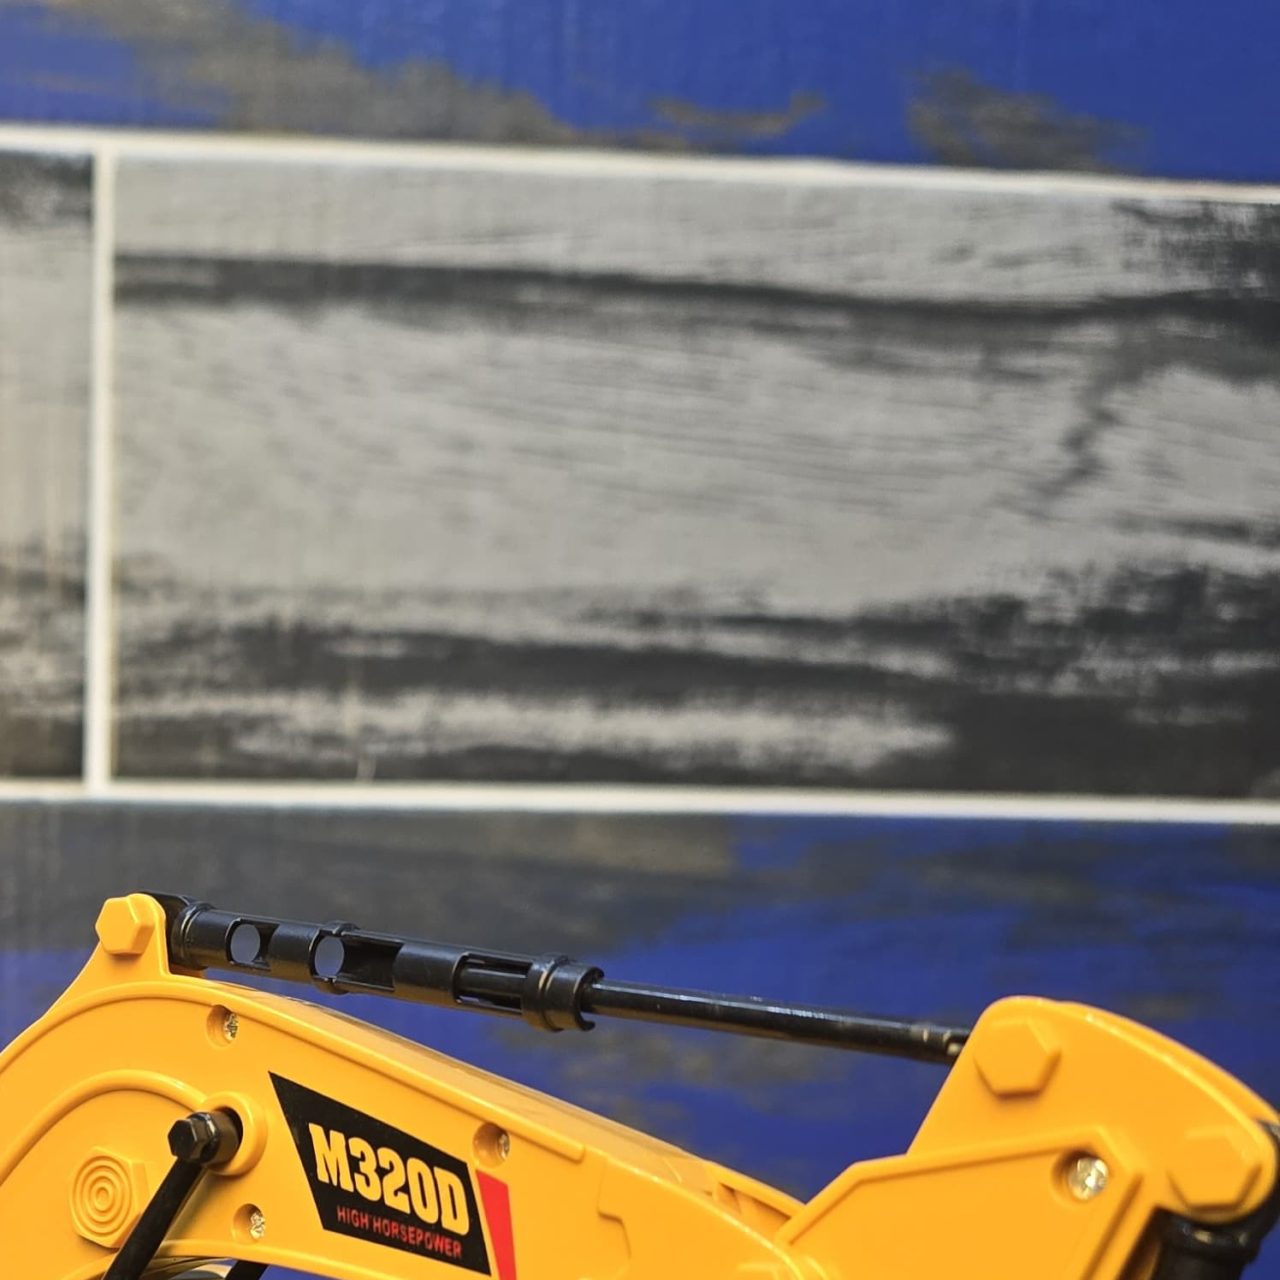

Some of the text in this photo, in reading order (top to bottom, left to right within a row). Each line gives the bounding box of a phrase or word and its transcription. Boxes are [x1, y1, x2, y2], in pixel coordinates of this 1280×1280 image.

[308, 1123, 469, 1236] M320D
[337, 1205, 462, 1258] HIGH HORSEPOWER
